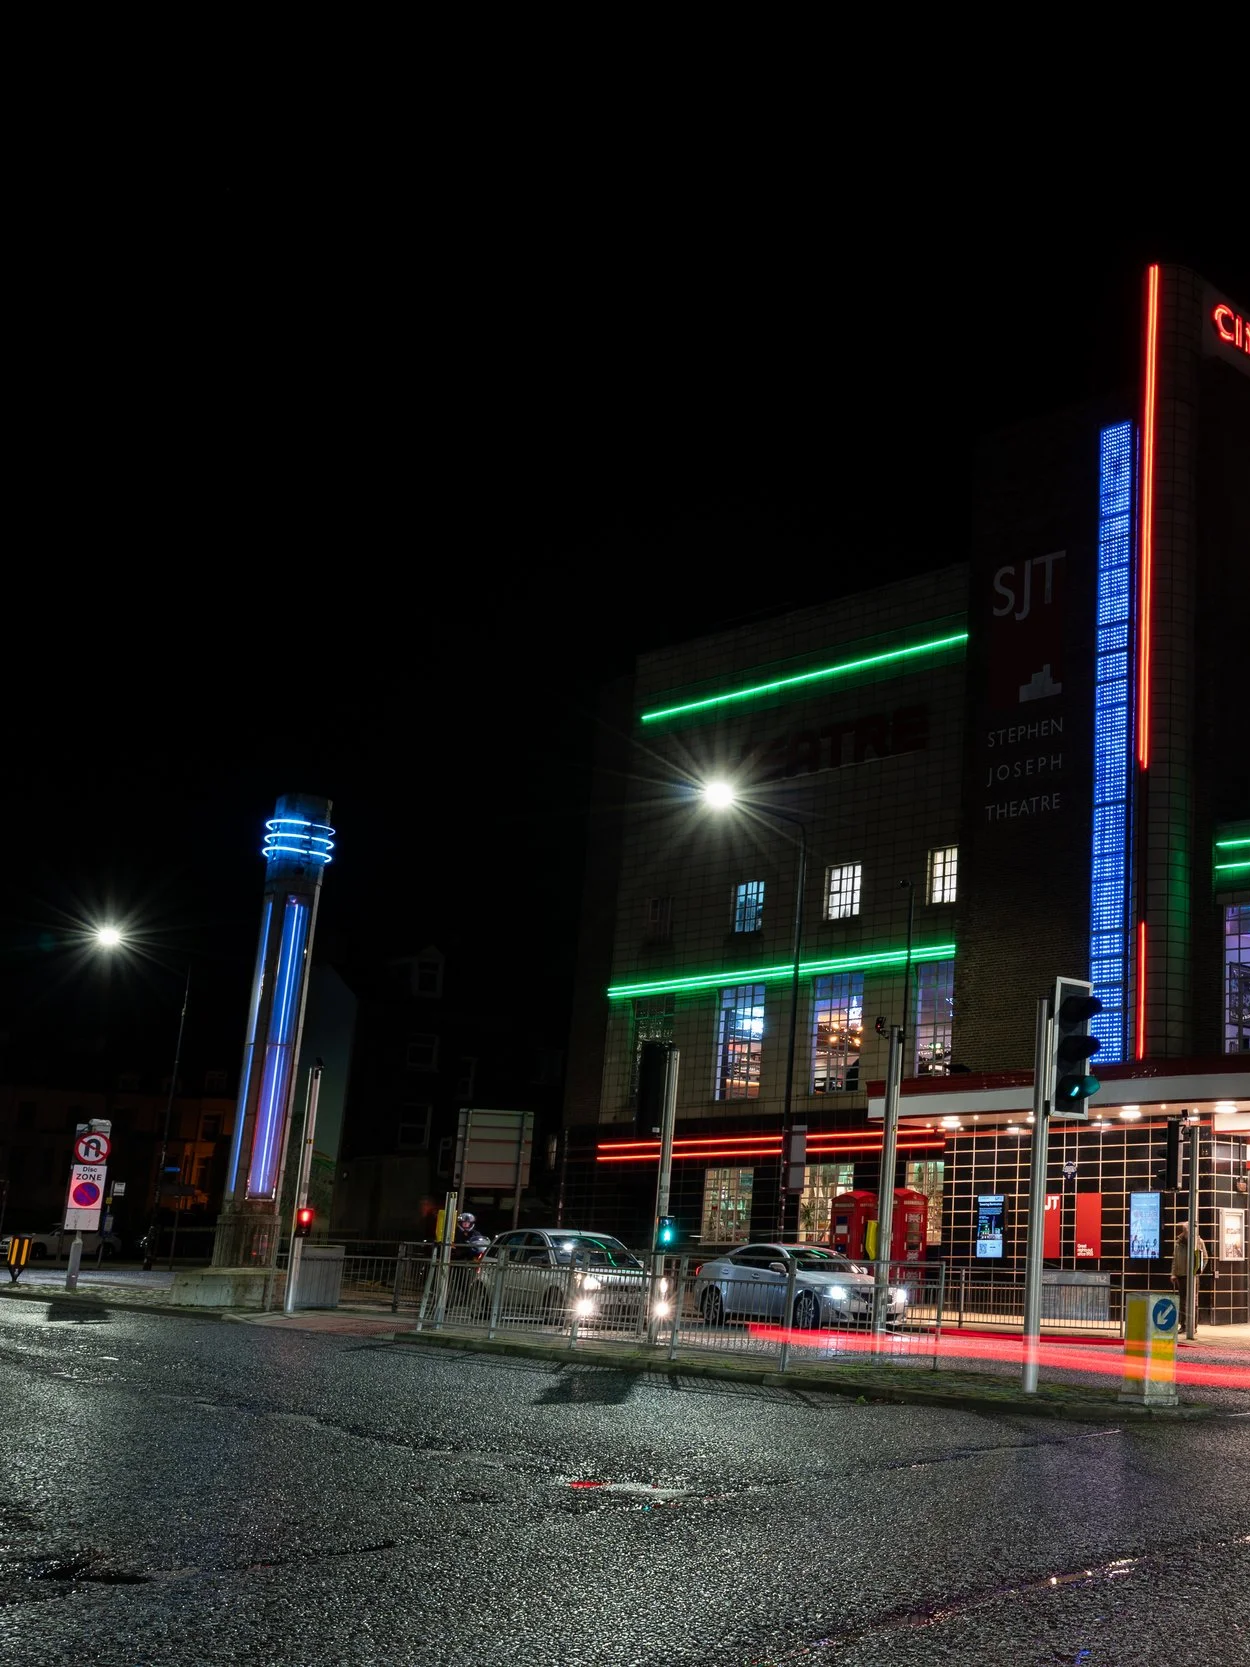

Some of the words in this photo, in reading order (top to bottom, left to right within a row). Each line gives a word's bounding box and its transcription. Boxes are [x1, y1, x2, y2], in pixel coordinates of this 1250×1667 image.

[991, 548, 1068, 622] SJT
[986, 715, 1064, 748] STEPHEN
[985, 752, 1063, 788] JOSEPH
[984, 791, 1061, 824] THEATRE
[76, 1173, 102, 1181] ZONE
[1044, 1195, 1060, 1211] JT
